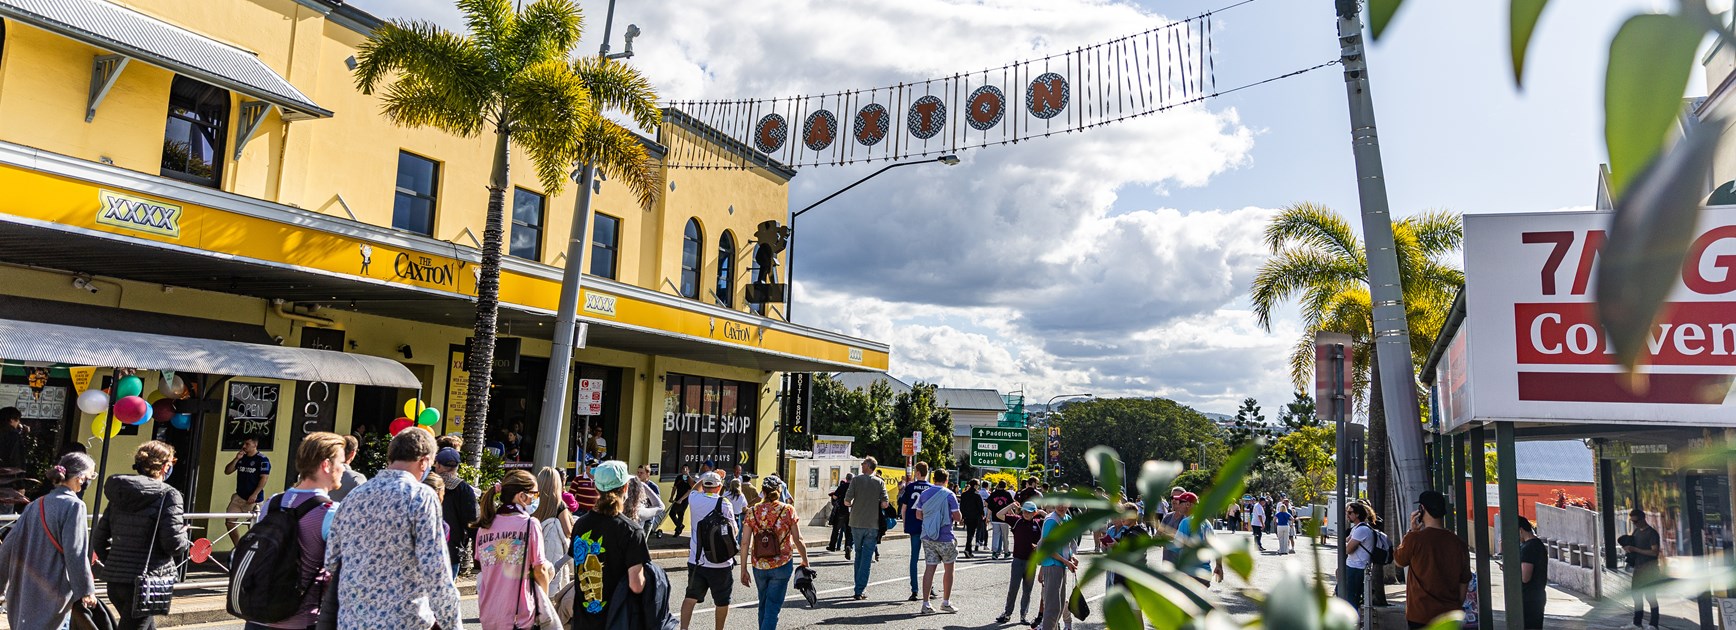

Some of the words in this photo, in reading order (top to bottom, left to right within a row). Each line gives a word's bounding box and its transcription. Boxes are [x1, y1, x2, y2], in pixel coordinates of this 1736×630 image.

[761, 79, 1062, 148] CAXTON
[104, 195, 175, 230] XXXX
[394, 252, 455, 287] CAXTON
[419, 256, 432, 267] THE
[587, 294, 614, 313] XXXX
[723, 321, 751, 342] CAXTON
[1530, 312, 1736, 356] Coven
[231, 383, 278, 402] POKIES
[238, 403, 264, 417] OPEN
[230, 421, 240, 434] 7
[244, 420, 270, 435] DAYS
[665, 411, 716, 433] BOTTLE
[720, 415, 750, 434] SHOP
[985, 430, 1022, 438] Paddington
[685, 454, 704, 462] OPEN
[714, 454, 730, 462] DAYS
